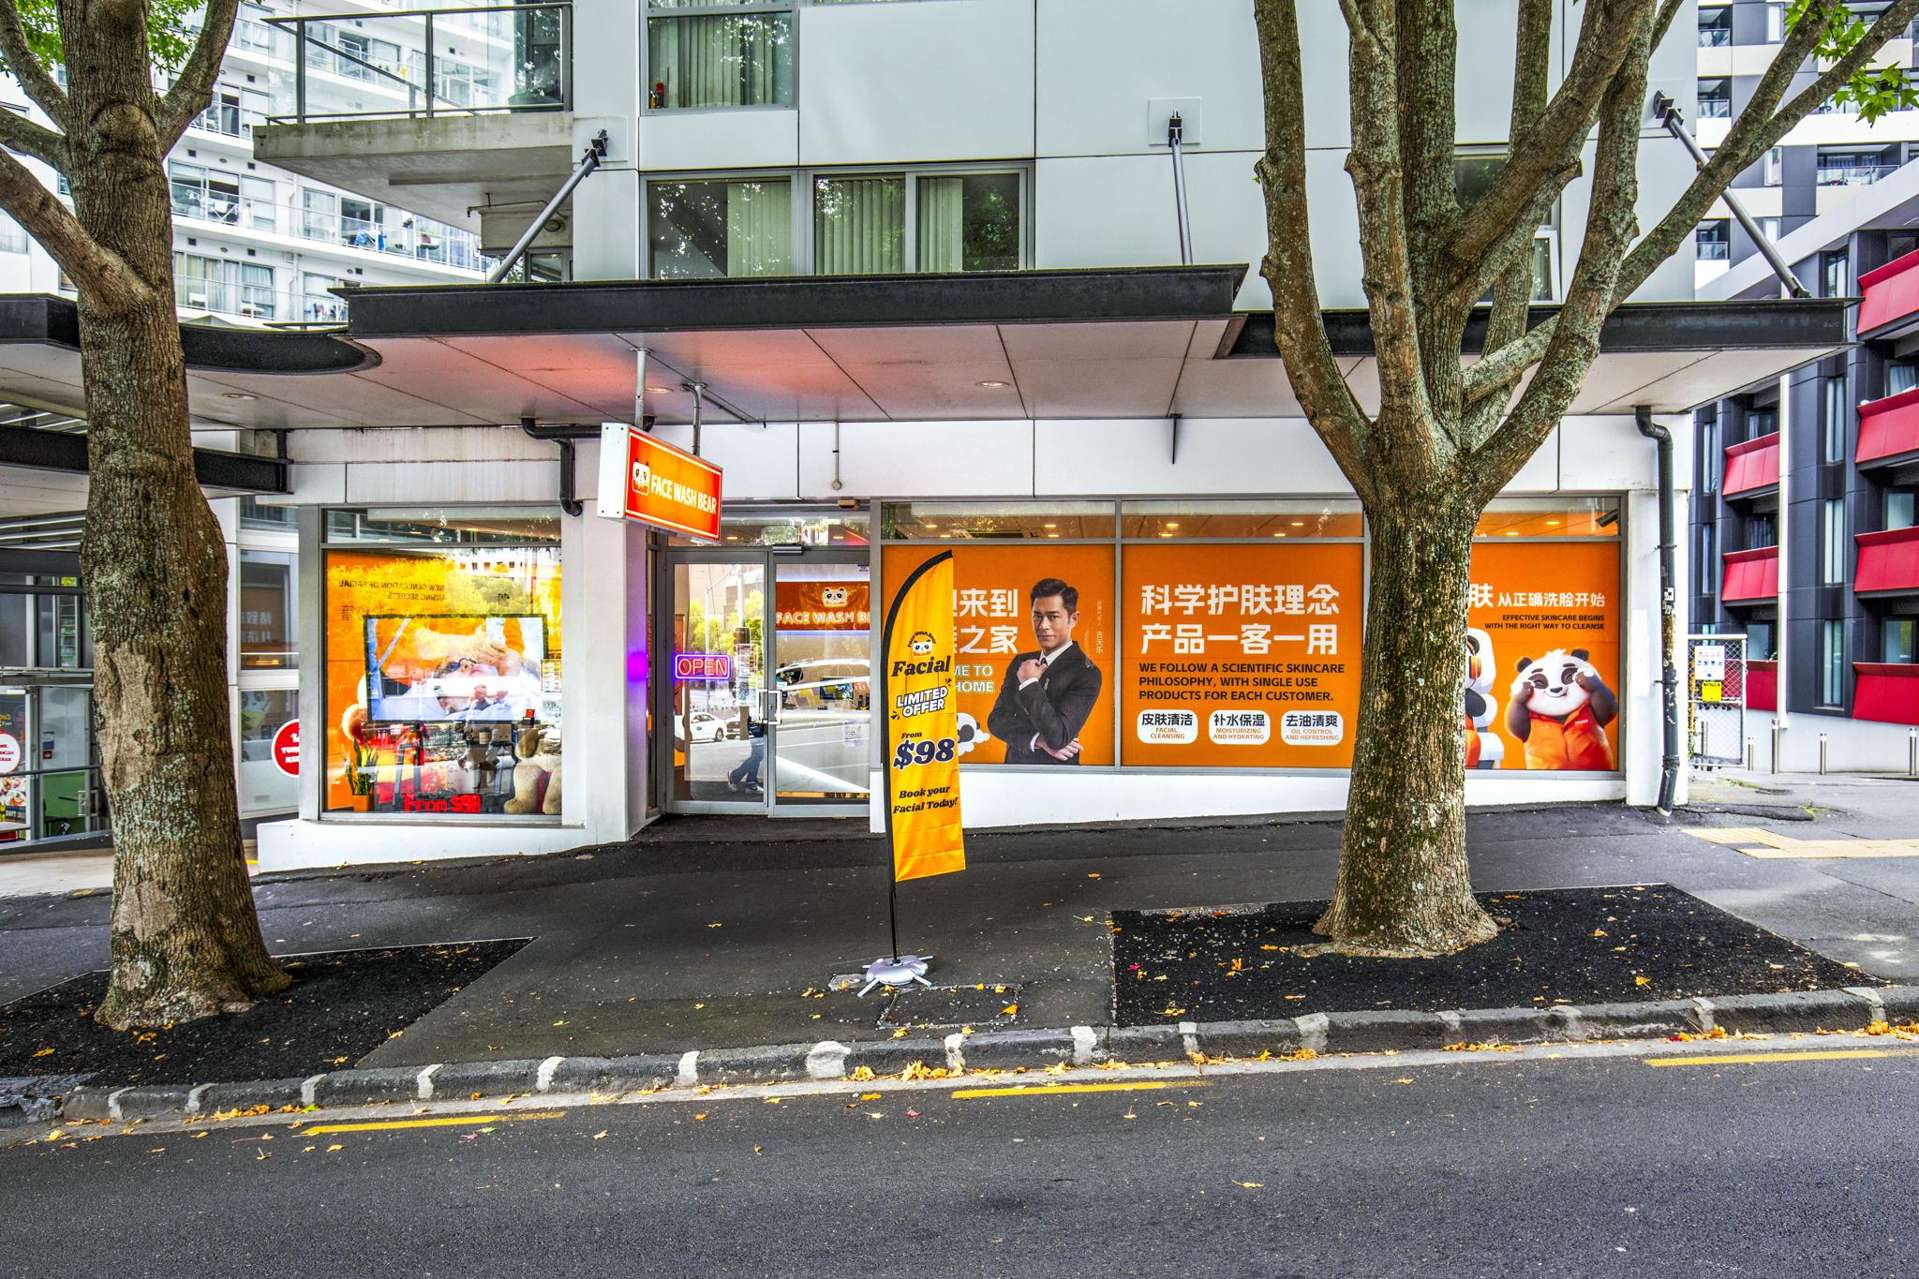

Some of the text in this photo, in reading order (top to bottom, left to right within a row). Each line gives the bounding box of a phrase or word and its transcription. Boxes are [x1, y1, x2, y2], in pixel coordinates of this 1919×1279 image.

[651, 474, 717, 514] FACE WASH BEAR
[953, 588, 1018, 617] 来到
[1141, 584, 1340, 616] 科学护肤理念
[1497, 592, 1605, 608] 从正确洗脸开始
[813, 611, 855, 625] WASH
[954, 625, 1018, 655] 之家
[1141, 623, 1338, 655] 产品一客一用
[678, 658, 728, 677] OPEN
[891, 655, 951, 677] Facial
[974, 665, 993, 677] TO
[1139, 663, 1345, 673] WE FOLLOW A SCIENTIFIC SKINCARE
[1139, 676, 1318, 688] PHILOSOPHY, WITH SINGLE USE
[896, 686, 948, 708] LIMITED
[1139, 690, 1334, 701] PRODUCTS FOR EACH CUSTOMER.
[902, 698, 945, 718] OFFER
[1142, 713, 1193, 726] 皮肤清洁
[1213, 714, 1265, 727] 补水保湿
[1286, 715, 1338, 728] 去油清爽
[893, 738, 956, 771] $98
[899, 786, 951, 799] Book your
[893, 797, 958, 814] Facial Today!
